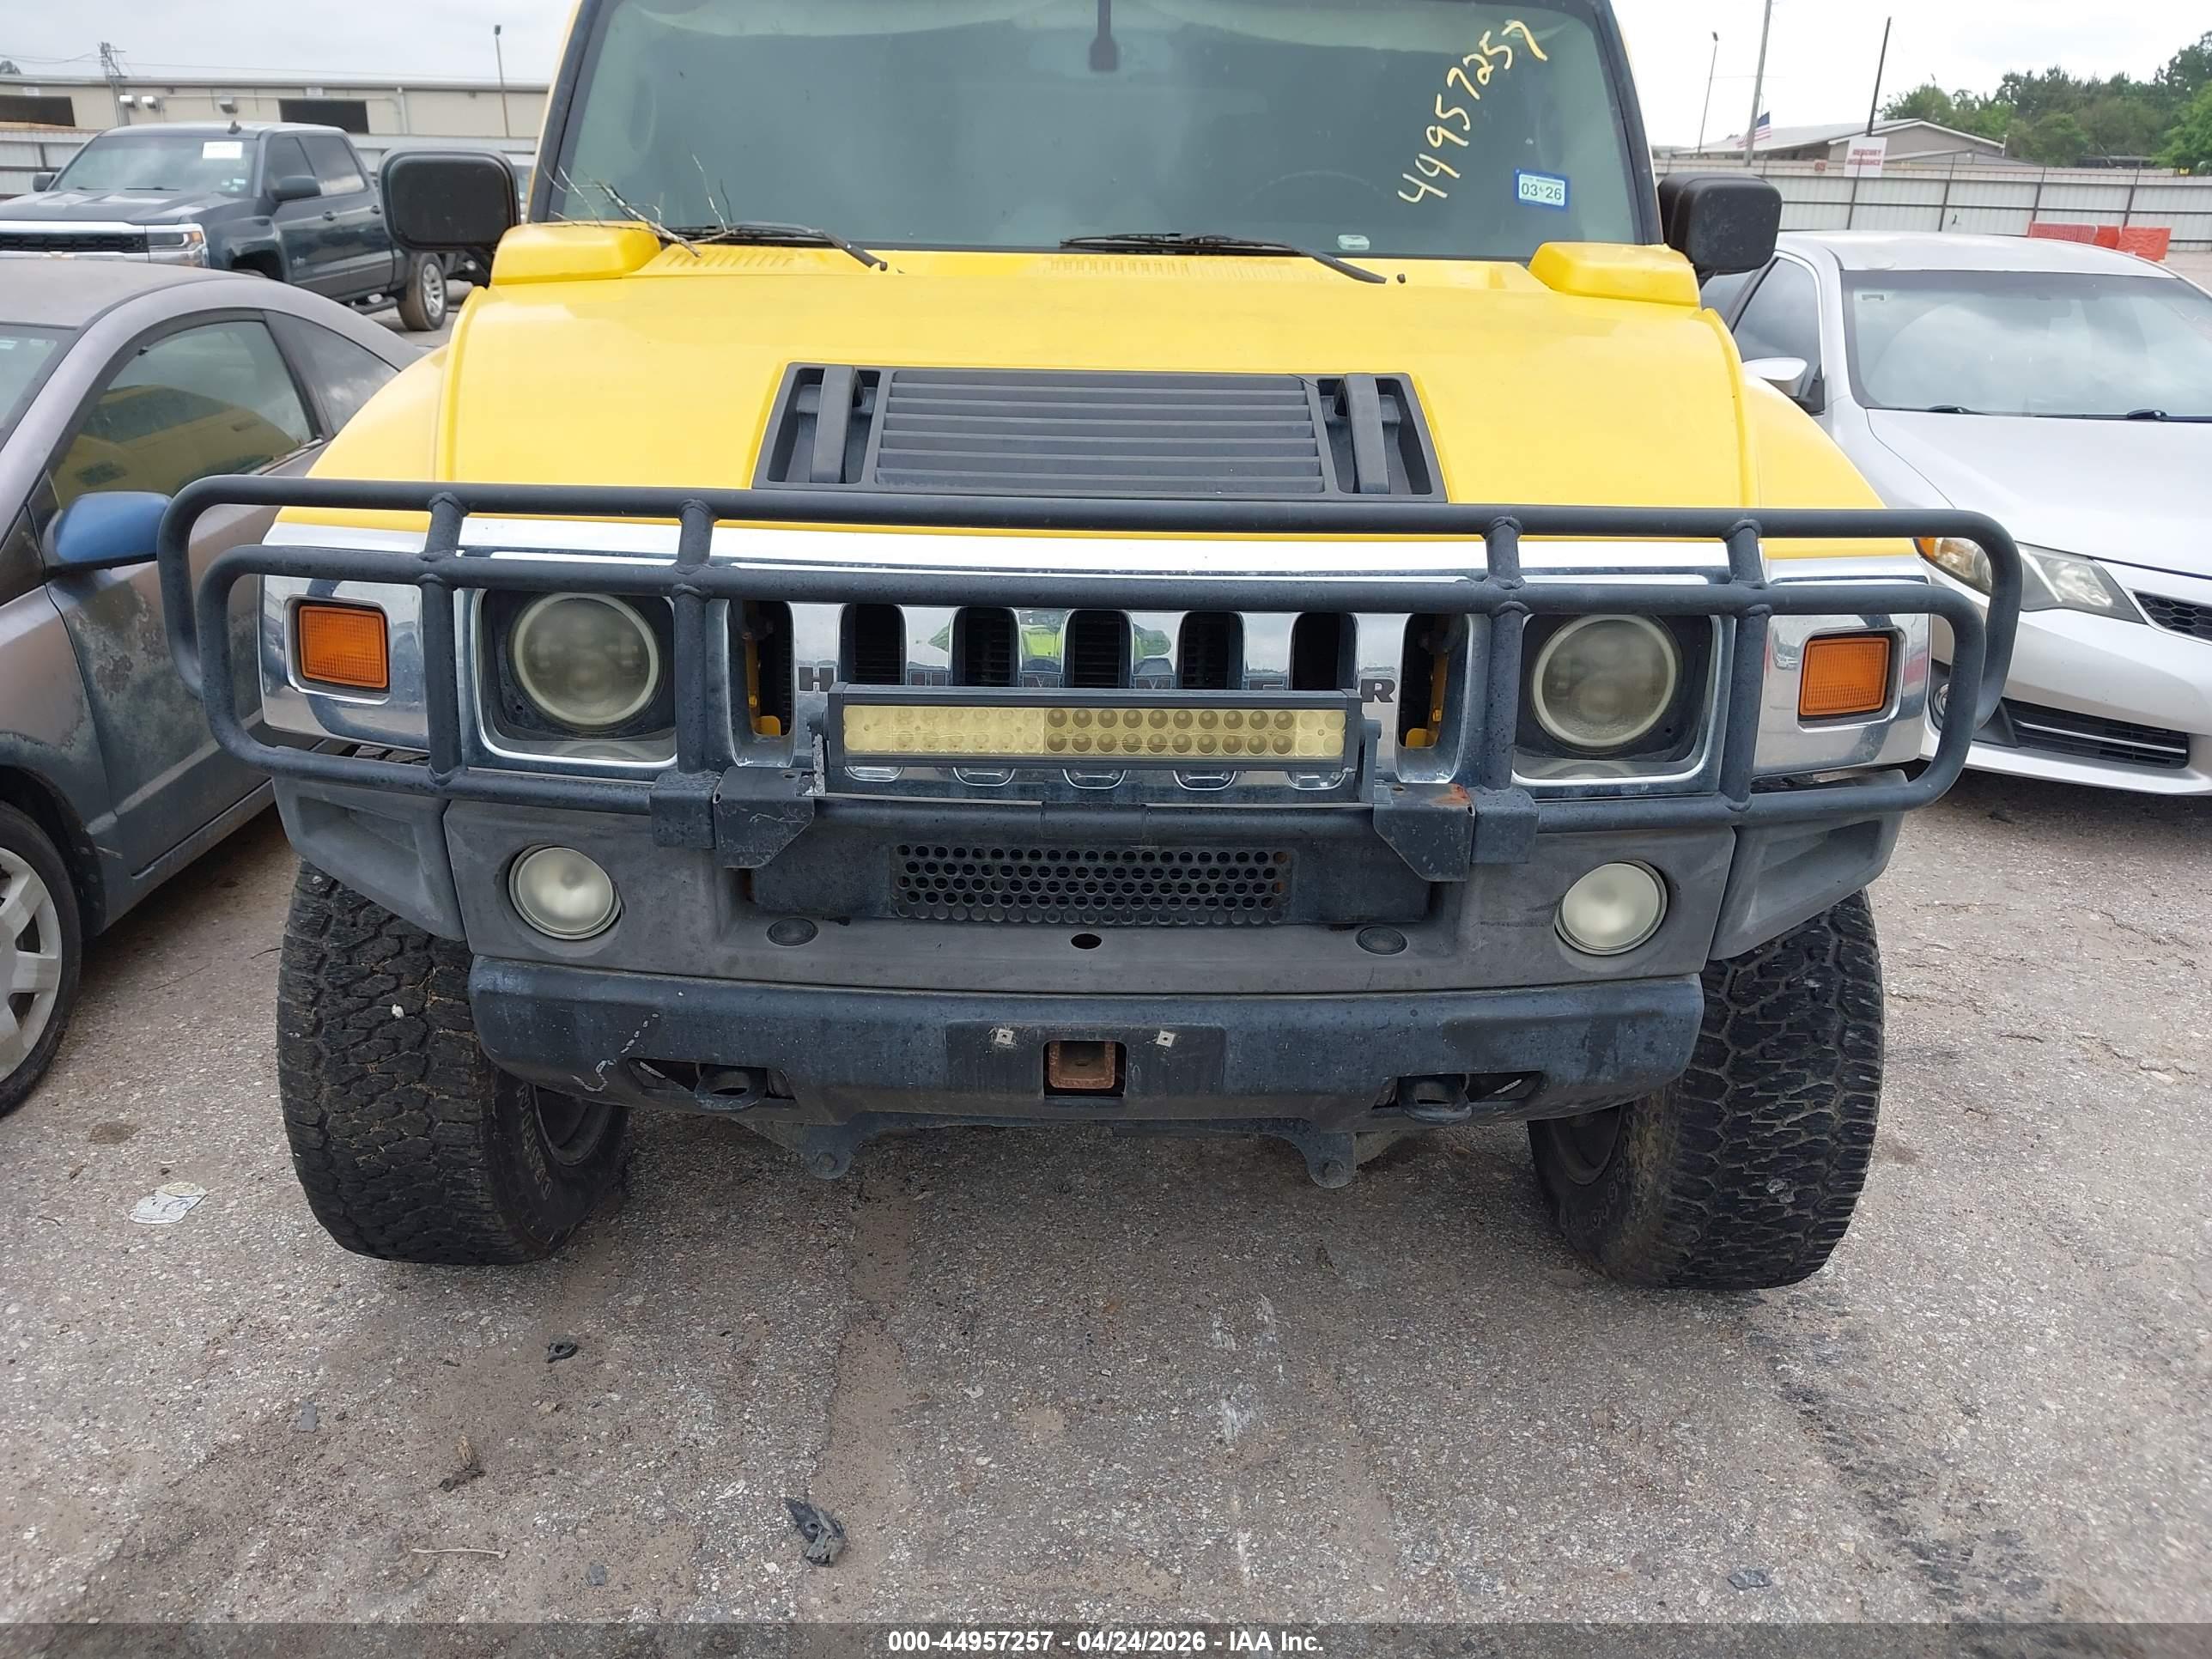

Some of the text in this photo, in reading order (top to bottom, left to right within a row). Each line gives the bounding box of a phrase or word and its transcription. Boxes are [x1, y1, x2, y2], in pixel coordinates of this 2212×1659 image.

[1397, 20, 1548, 204] 44957257
[1521, 182, 1562, 200] 03 26
